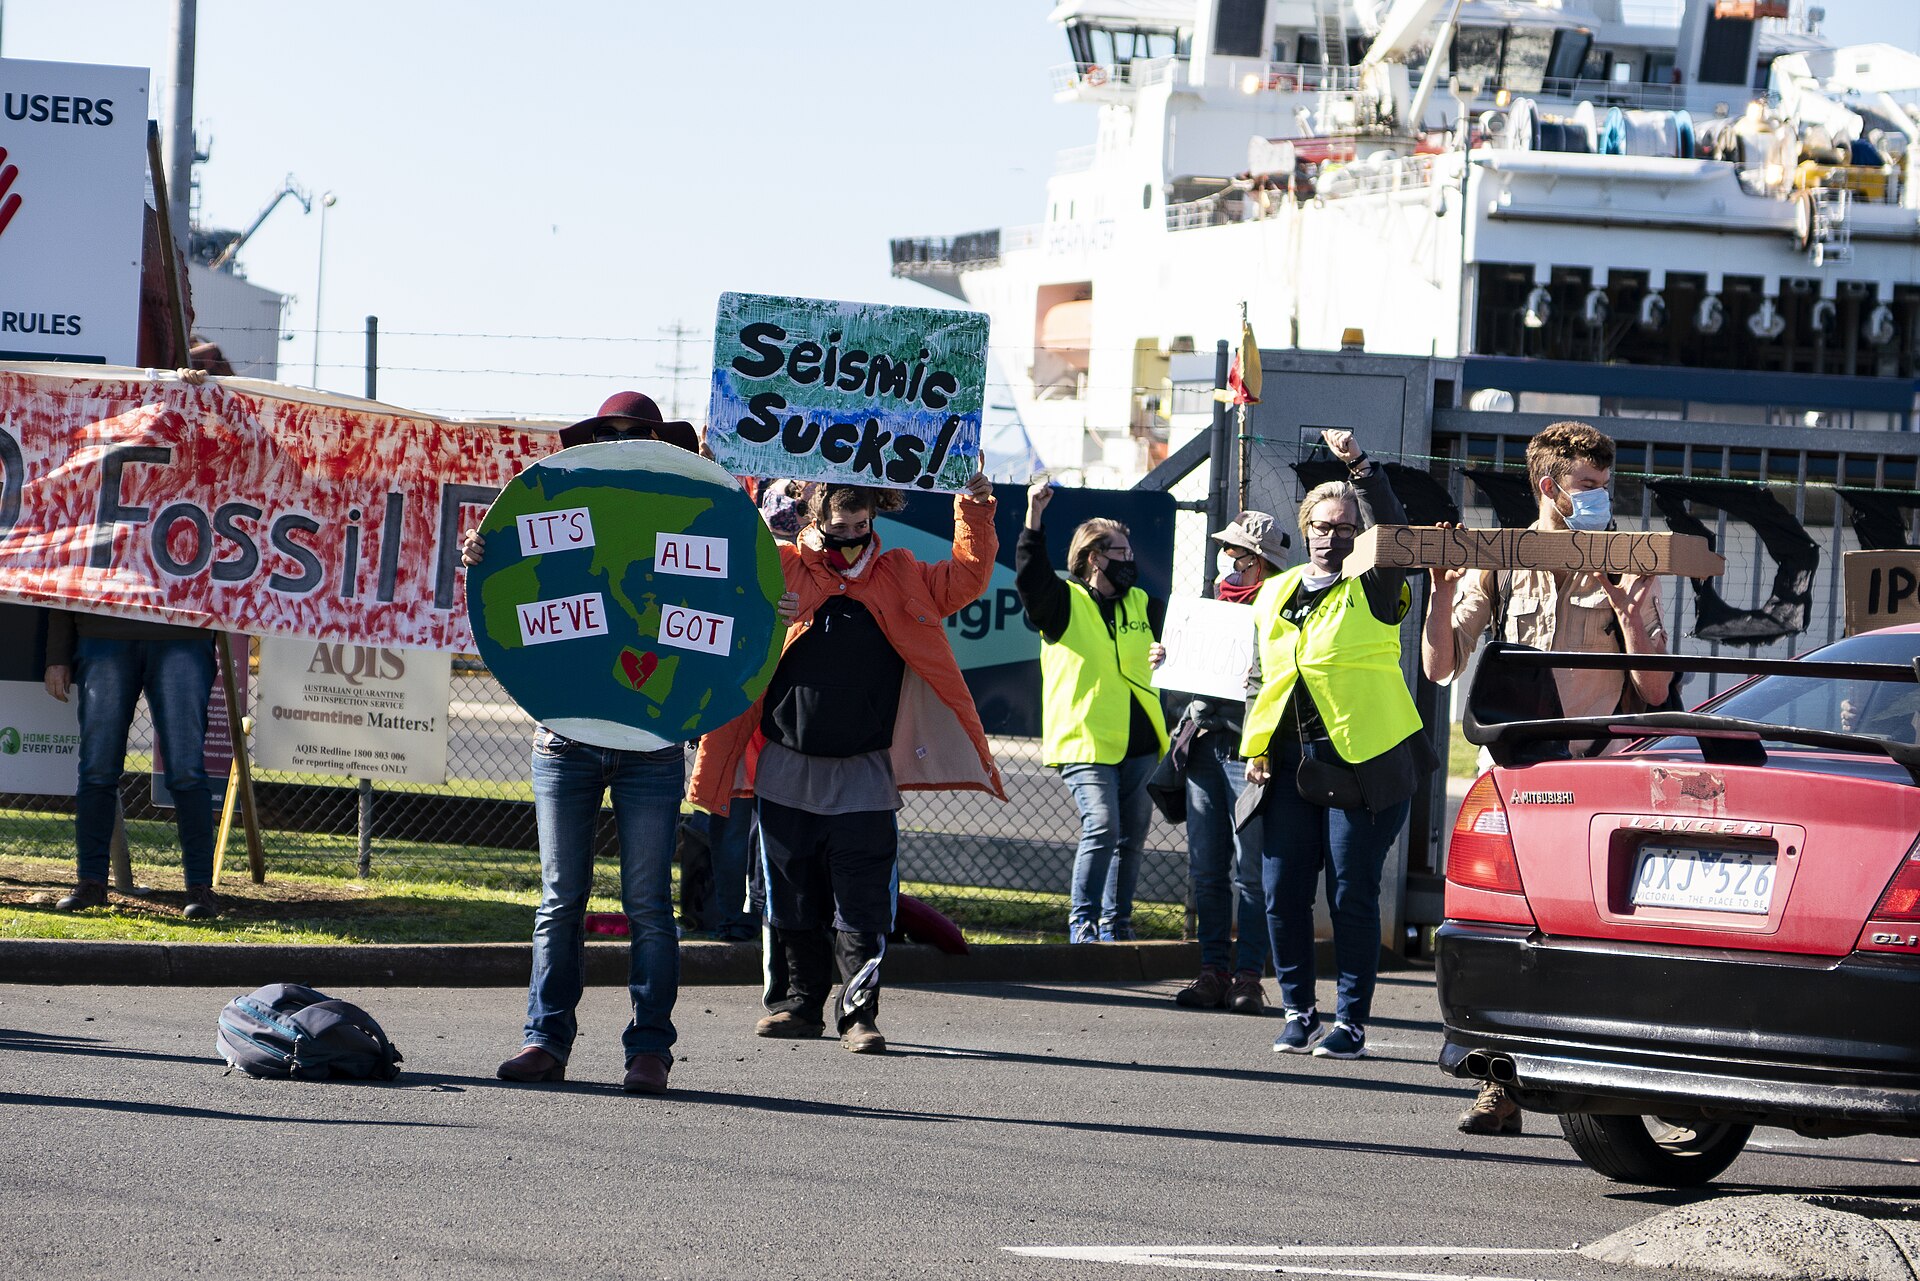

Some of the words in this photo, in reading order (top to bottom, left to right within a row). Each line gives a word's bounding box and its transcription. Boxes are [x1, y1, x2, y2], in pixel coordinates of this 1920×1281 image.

[4, 92, 114, 126] USERS
[1, 311, 81, 336] RULES
[526, 512, 585, 549] IT'S
[661, 541, 721, 572] ALL
[1392, 526, 1539, 570] SEISMIC
[1566, 531, 1660, 574] SUCKS
[524, 598, 599, 637] WE'VE
[666, 611, 724, 645] GOT
[306, 642, 405, 685] AQIS
[304, 684, 351, 695] AUSTRALIAN
[353, 688, 405, 699] QUARANTINE
[303, 694, 319, 702] AND
[320, 695, 368, 707] INSPECTION
[370, 700, 404, 710] SERVICE
[272, 705, 363, 726] Quarantine
[367, 711, 435, 732] Matters!
[23, 733, 50, 743] HOME
[22, 744, 53, 753] EVERY
[55, 745, 73, 754] DAY
[295, 744, 318, 755] AQIS
[320, 745, 351, 757] Redline
[354, 748, 372, 758] 1800
[374, 750, 389, 760] 803
[391, 752, 406, 761] 006
[292, 756, 304, 765] for
[306, 757, 344, 770] reporting
[346, 761, 379, 772] offences
[380, 763, 408, 774] ONLY
[1521, 791, 1575, 804] MITSUBISHI
[1629, 817, 1763, 836] LANCER
[1714, 858, 1773, 897] 526
[1636, 891, 1675, 901] VICTORIA
[1688, 894, 1704, 904] THE
[1708, 896, 1734, 906] PLACE
[1738, 898, 1749, 907] TO
[1753, 899, 1764, 908] BE
